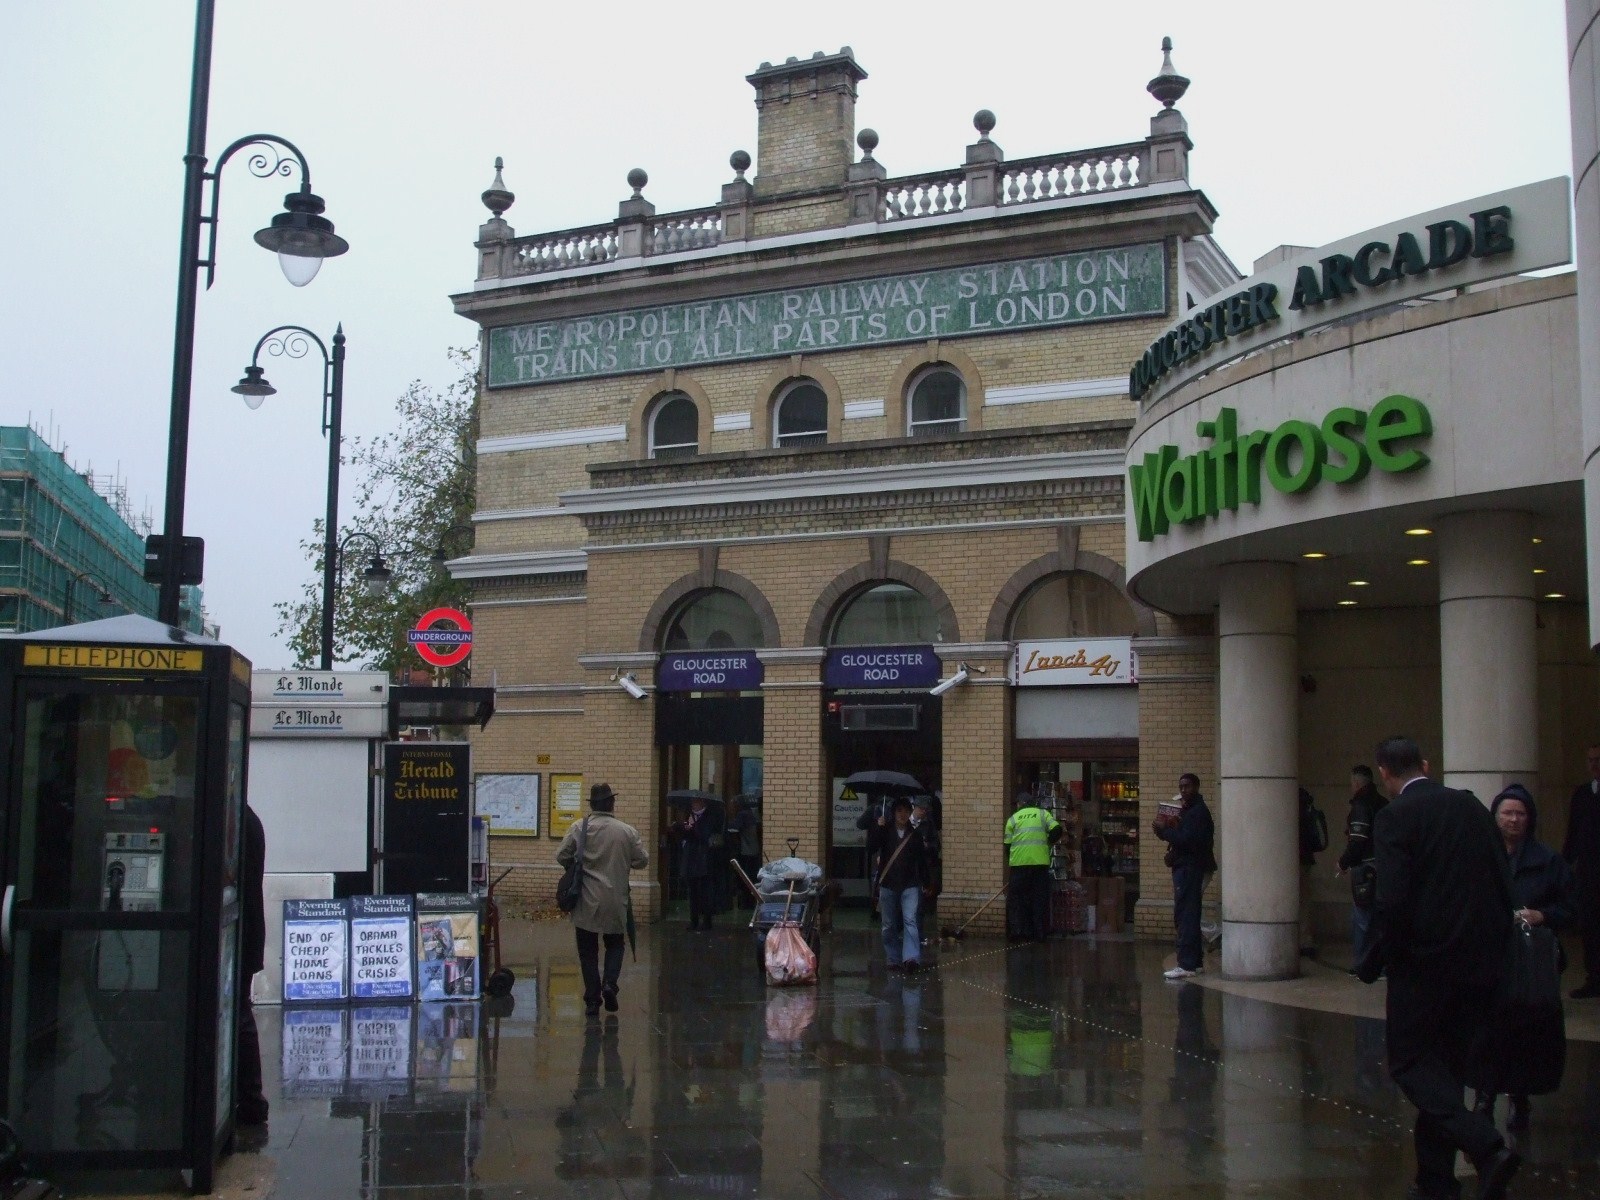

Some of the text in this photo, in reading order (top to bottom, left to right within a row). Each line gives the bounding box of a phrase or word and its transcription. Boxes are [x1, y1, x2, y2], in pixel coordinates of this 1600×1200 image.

[1288, 205, 1515, 311] ARCADE
[511, 252, 1130, 354] METROPOLITAN RAILWAY STATION
[513, 285, 1127, 381] TRAINS TO ALL PARTS OF LONDON
[1128, 394, 1434, 542] Waitrose
[410, 633, 472, 641] UNDERGROUN
[41, 647, 187, 670] TELEPHONE
[841, 653, 923, 667] GLOUCESTER
[1023, 648, 1088, 674] Lunch
[673, 658, 748, 671] GLOUCESTER
[693, 673, 726, 684] ROAD
[863, 668, 900, 681] ROAD
[276, 676, 344, 691] Le Monde
[275, 710, 342, 725] Le Monde
[400, 760, 455, 778] Herald
[394, 782, 459, 800] Tribune
[834, 804, 863, 812] Caution
[298, 901, 341, 910] Evening
[364, 897, 406, 906] Evening
[298, 908, 346, 917] Standard
[363, 905, 411, 913] Standard
[289, 931, 335, 943] END OF
[360, 930, 398, 940] OBAMA
[290, 945, 330, 956] CHEAP
[355, 943, 403, 954] TACKLES
[294, 958, 329, 968] HOME
[361, 955, 398, 966] BANKS
[292, 970, 333, 981] LOANS
[358, 968, 397, 979] CRISIS
